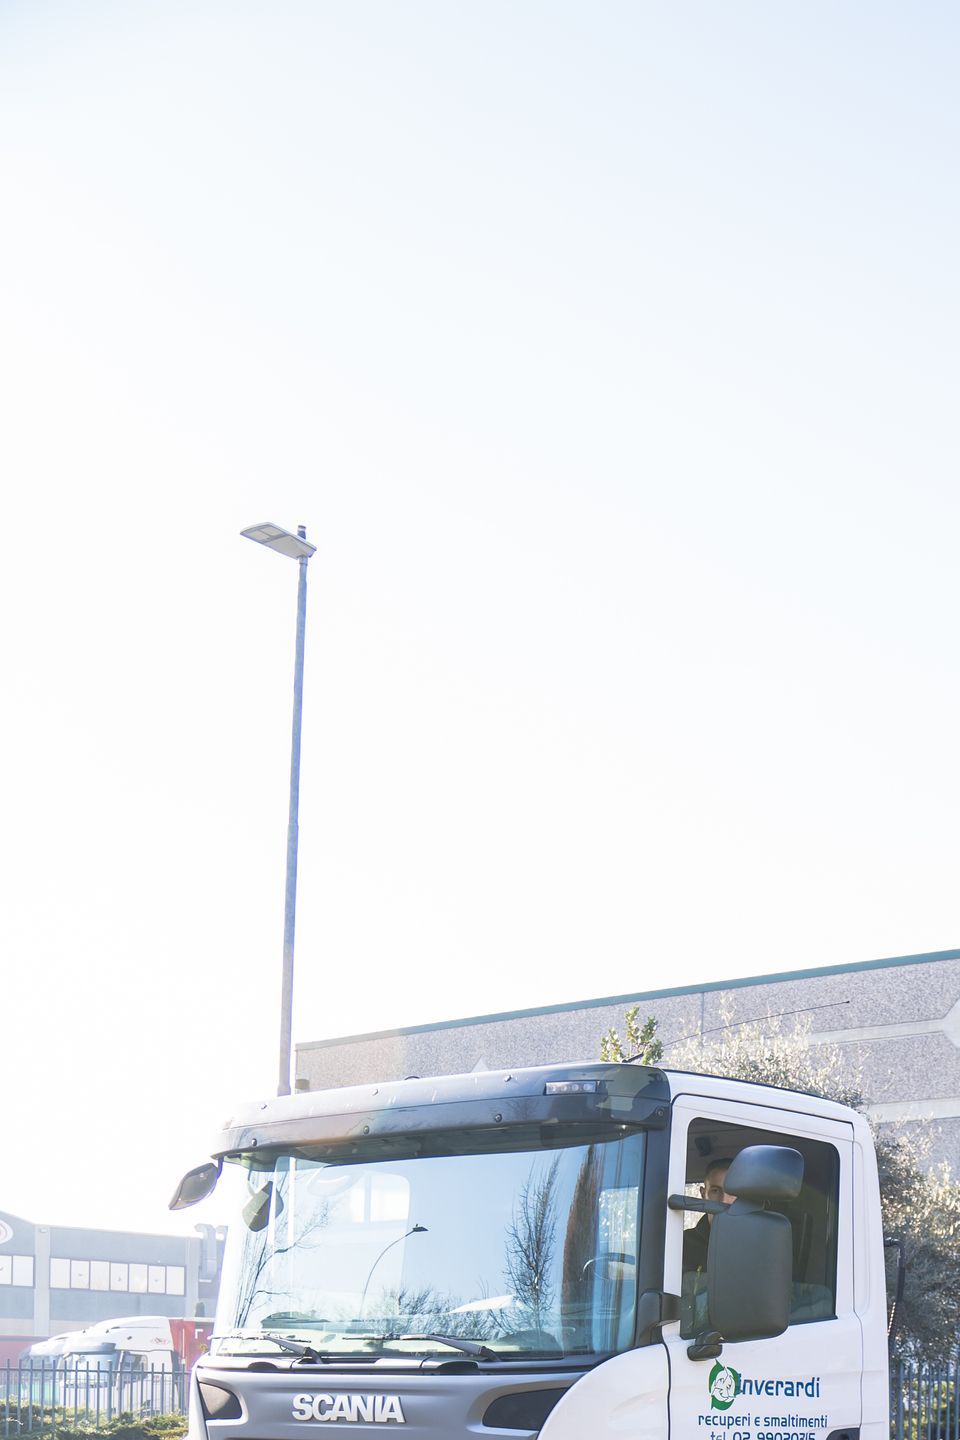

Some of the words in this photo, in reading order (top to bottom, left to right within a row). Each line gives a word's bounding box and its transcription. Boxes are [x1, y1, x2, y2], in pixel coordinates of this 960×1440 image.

[737, 1373, 820, 1398] inverardi
[291, 1393, 406, 1423] SCANIA
[698, 1413, 751, 1430] recuperi
[754, 1416, 761, 1427] e
[763, 1414, 828, 1428] smaltimenti
